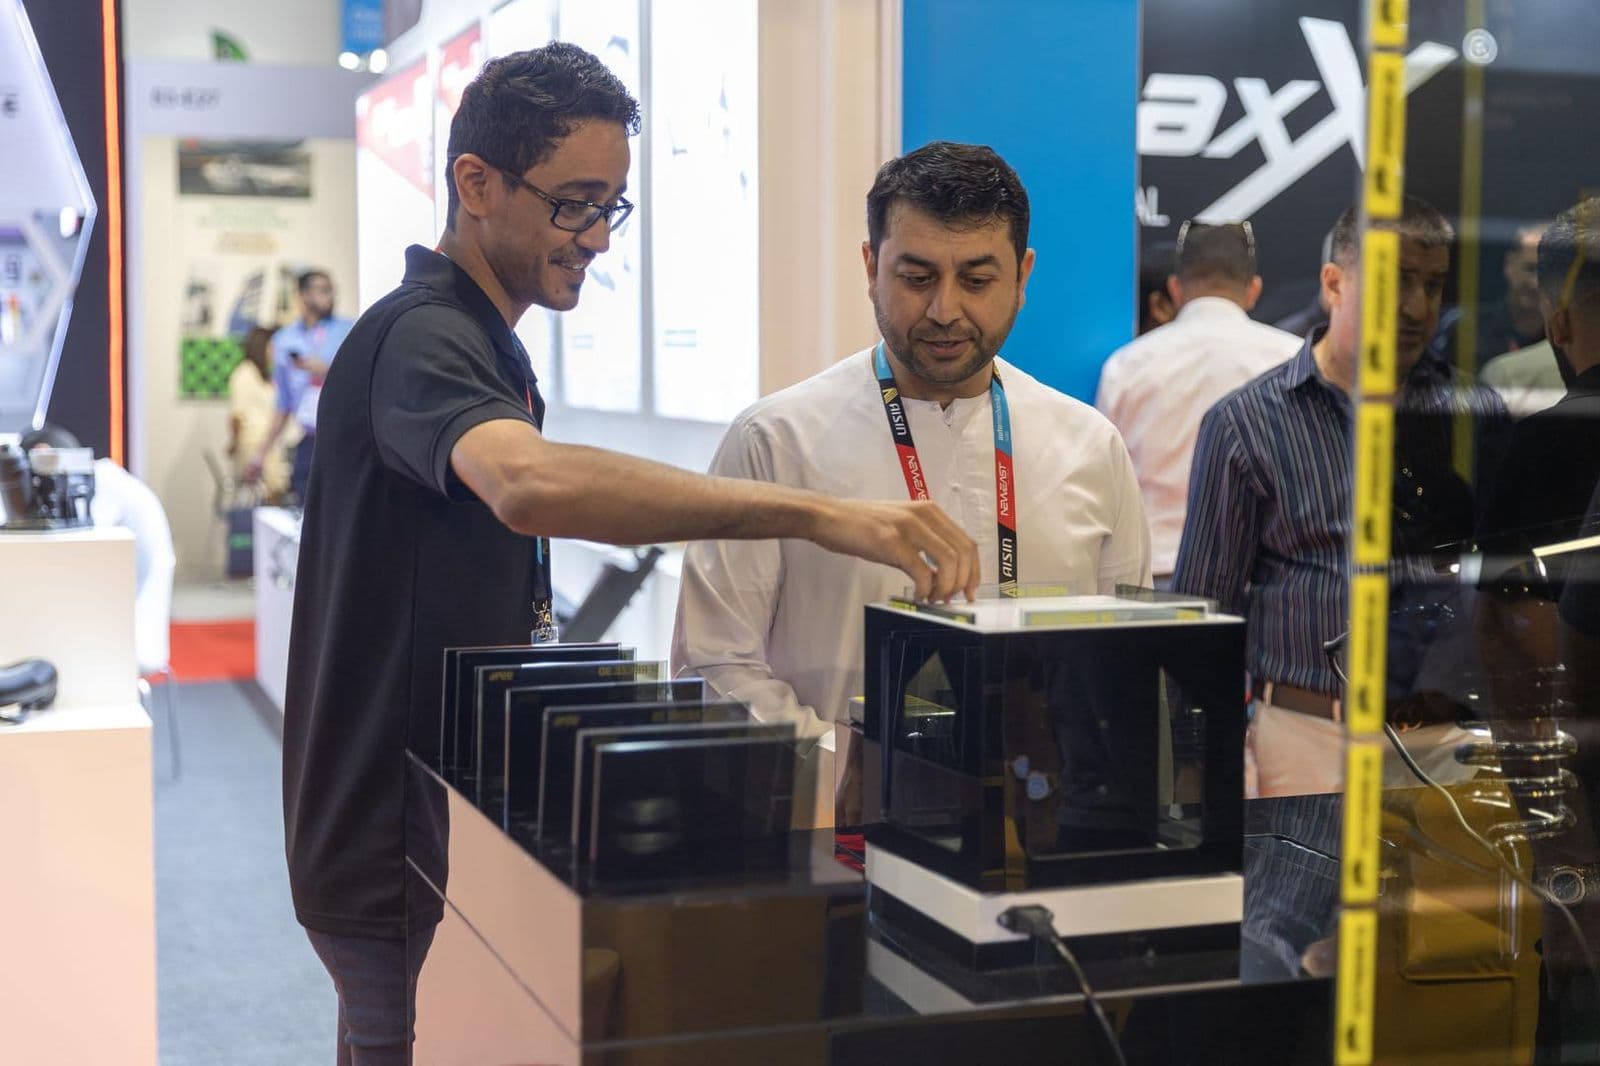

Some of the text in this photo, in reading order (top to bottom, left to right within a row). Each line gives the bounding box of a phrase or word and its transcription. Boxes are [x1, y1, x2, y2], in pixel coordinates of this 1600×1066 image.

[1136, 15, 1459, 225] axX
[889, 403, 907, 436] AISIN
[907, 455, 928, 502] NEWEAS
[998, 462, 1010, 516] NEWEAST
[1002, 538, 1013, 578] AISIN
